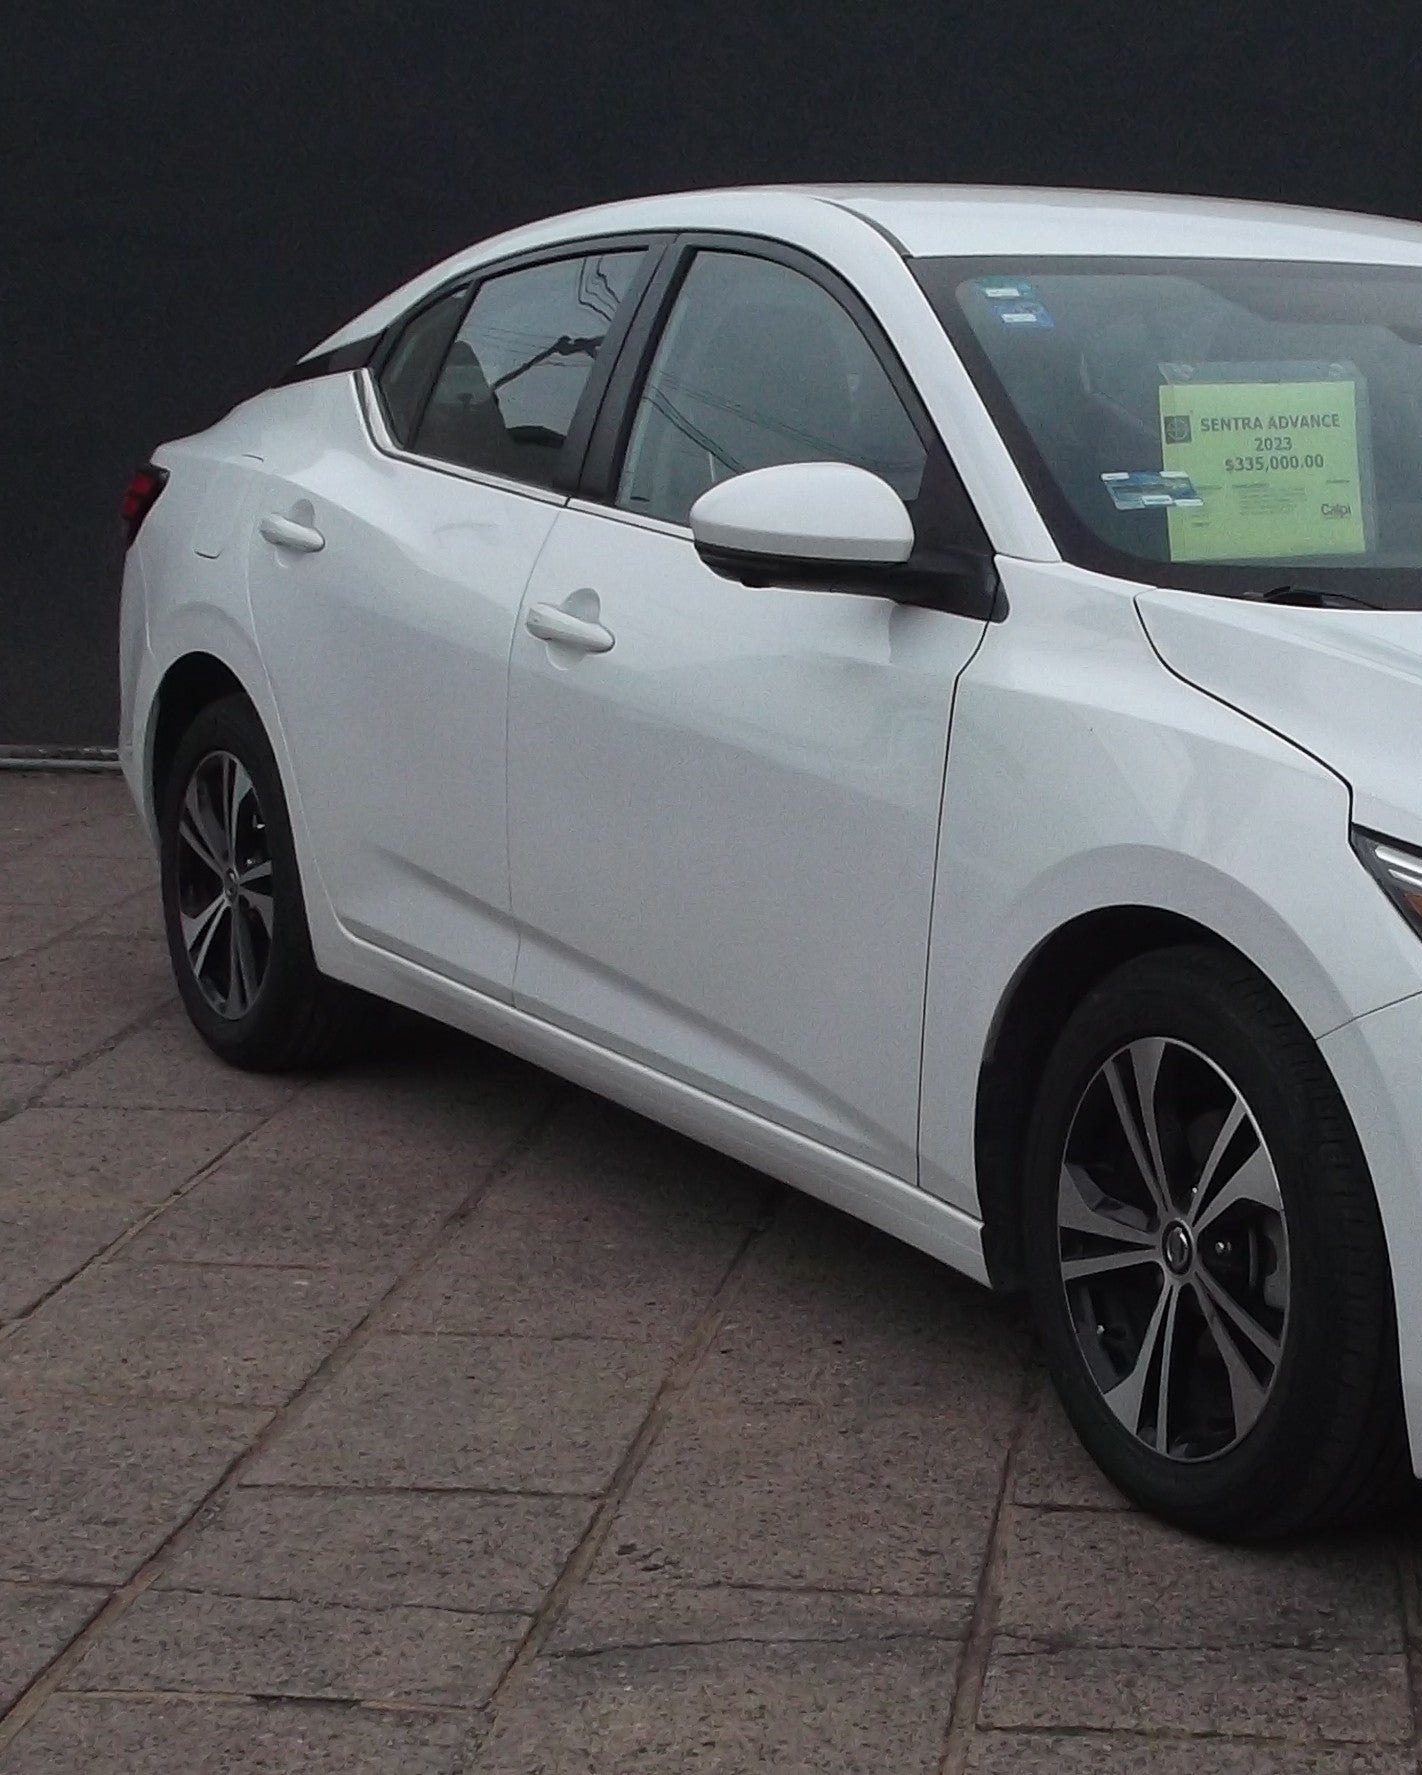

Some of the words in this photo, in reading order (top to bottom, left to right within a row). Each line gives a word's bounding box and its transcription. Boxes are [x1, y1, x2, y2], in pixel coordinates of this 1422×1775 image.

[1200, 416, 1263, 432] SENTRA
[1268, 413, 1341, 430] ADVANCE
[1254, 436, 1293, 452] 2023
[1224, 453, 1324, 473] $335,000.00
